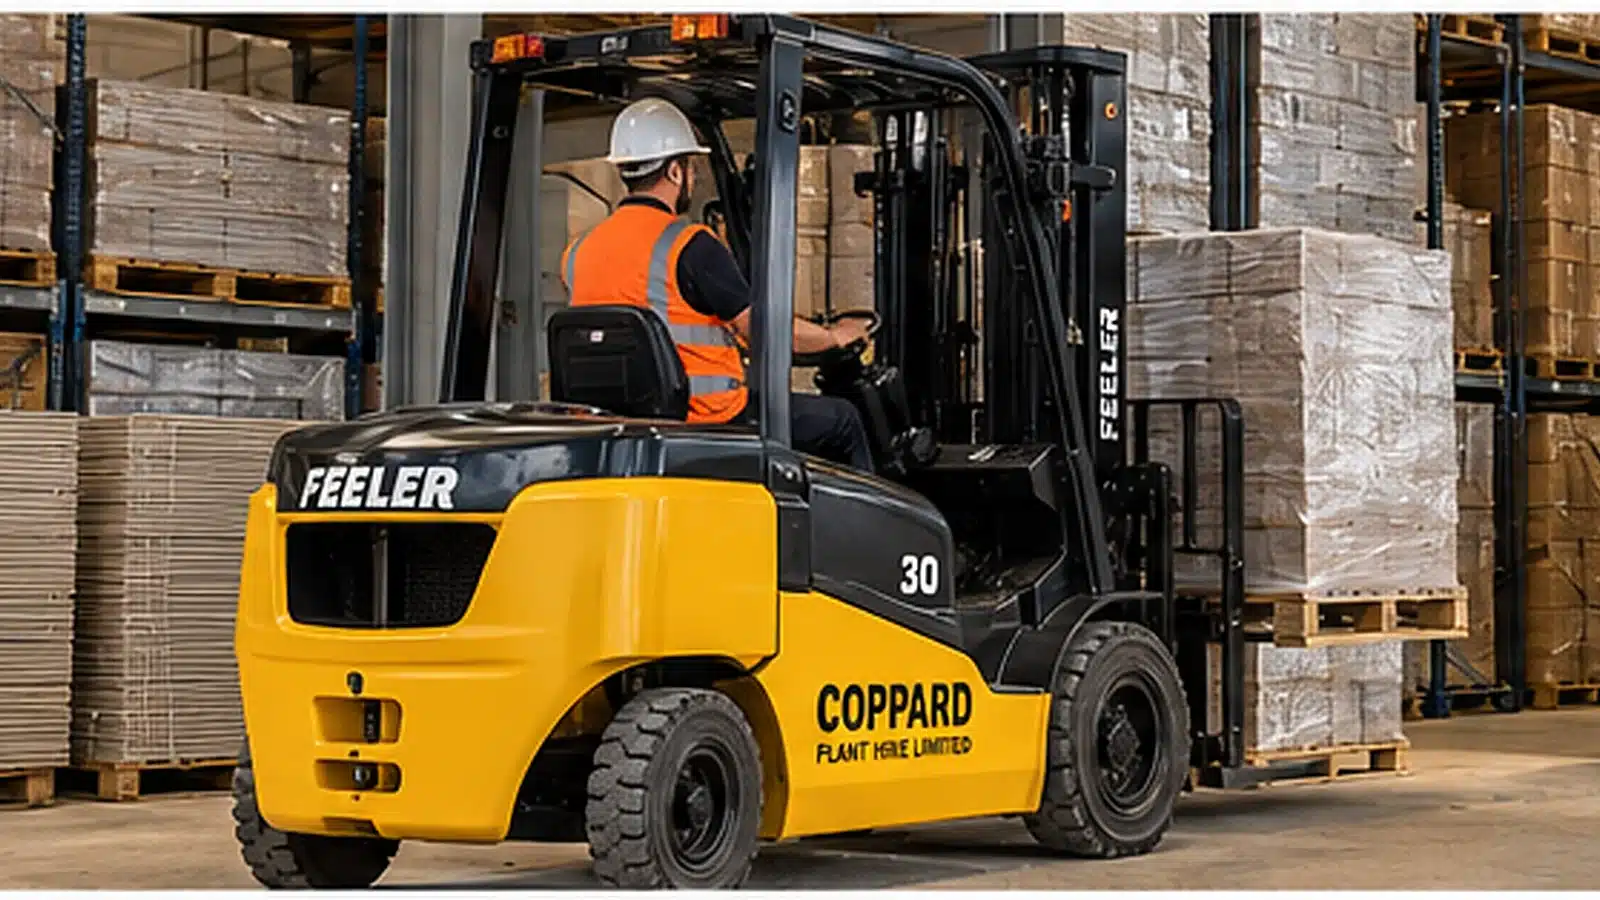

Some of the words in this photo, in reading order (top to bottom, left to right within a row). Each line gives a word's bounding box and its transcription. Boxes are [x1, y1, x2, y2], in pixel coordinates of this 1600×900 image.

[1100, 308, 1119, 441] FEELER
[300, 466, 458, 509] FEELER
[900, 554, 939, 595] 30
[816, 682, 972, 733] COPPARD
